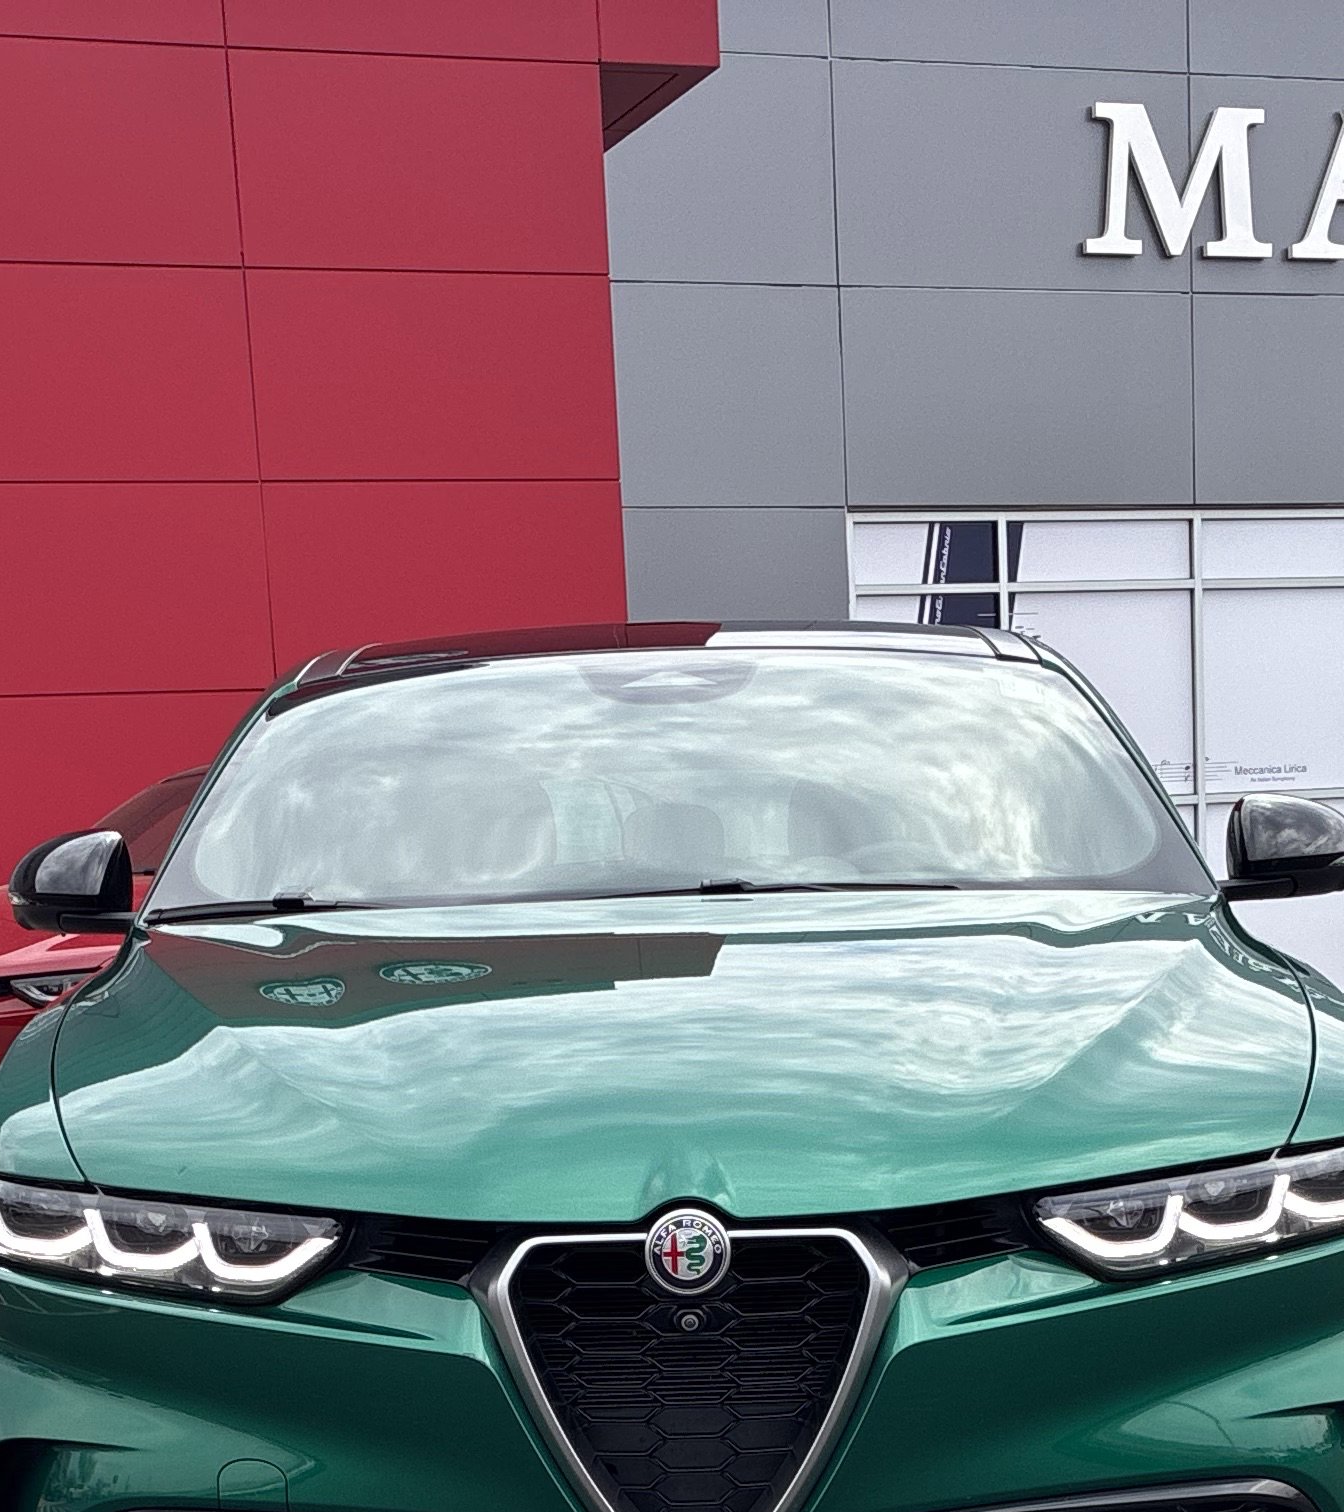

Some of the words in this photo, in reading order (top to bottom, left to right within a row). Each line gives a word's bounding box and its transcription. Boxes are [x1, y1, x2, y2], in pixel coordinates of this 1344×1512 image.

[1234, 765, 1281, 775] Meccanica
[1284, 764, 1307, 774] Lirica
[654, 1224, 676, 1255] ALFA
[682, 1219, 722, 1254] ROMEO
